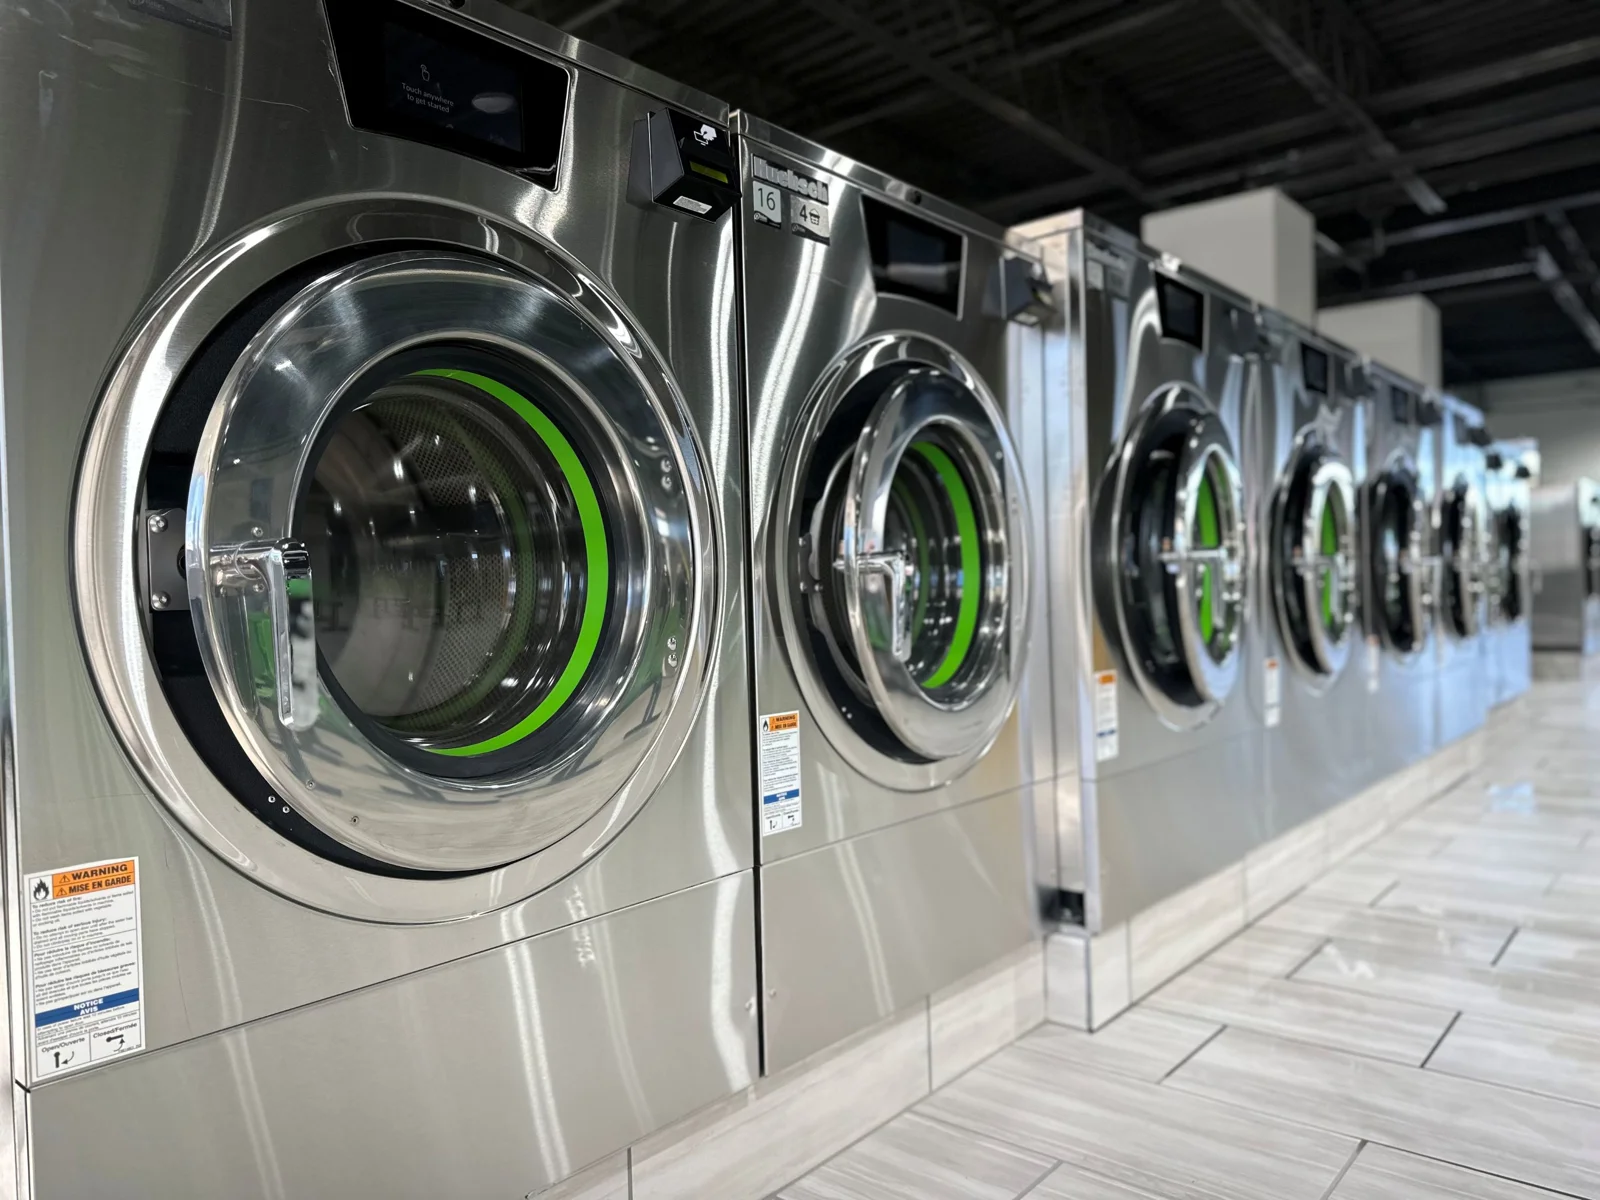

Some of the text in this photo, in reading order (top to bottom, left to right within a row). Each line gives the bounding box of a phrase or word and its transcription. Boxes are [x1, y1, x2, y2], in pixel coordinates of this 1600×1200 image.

[401, 82, 454, 106] Touch anywhere
[407, 93, 450, 113] to get started
[758, 188, 776, 211] 16
[799, 204, 807, 222] 4
[71, 863, 127, 880] WARNING
[68, 874, 131, 893] MISE EN GARDE
[74, 998, 103, 1010] NOTICE
[80, 1006, 98, 1015] AVIS
[93, 1022, 136, 1038] Closed/Fermée
[41, 1036, 84, 1053] Open/Ouverte
